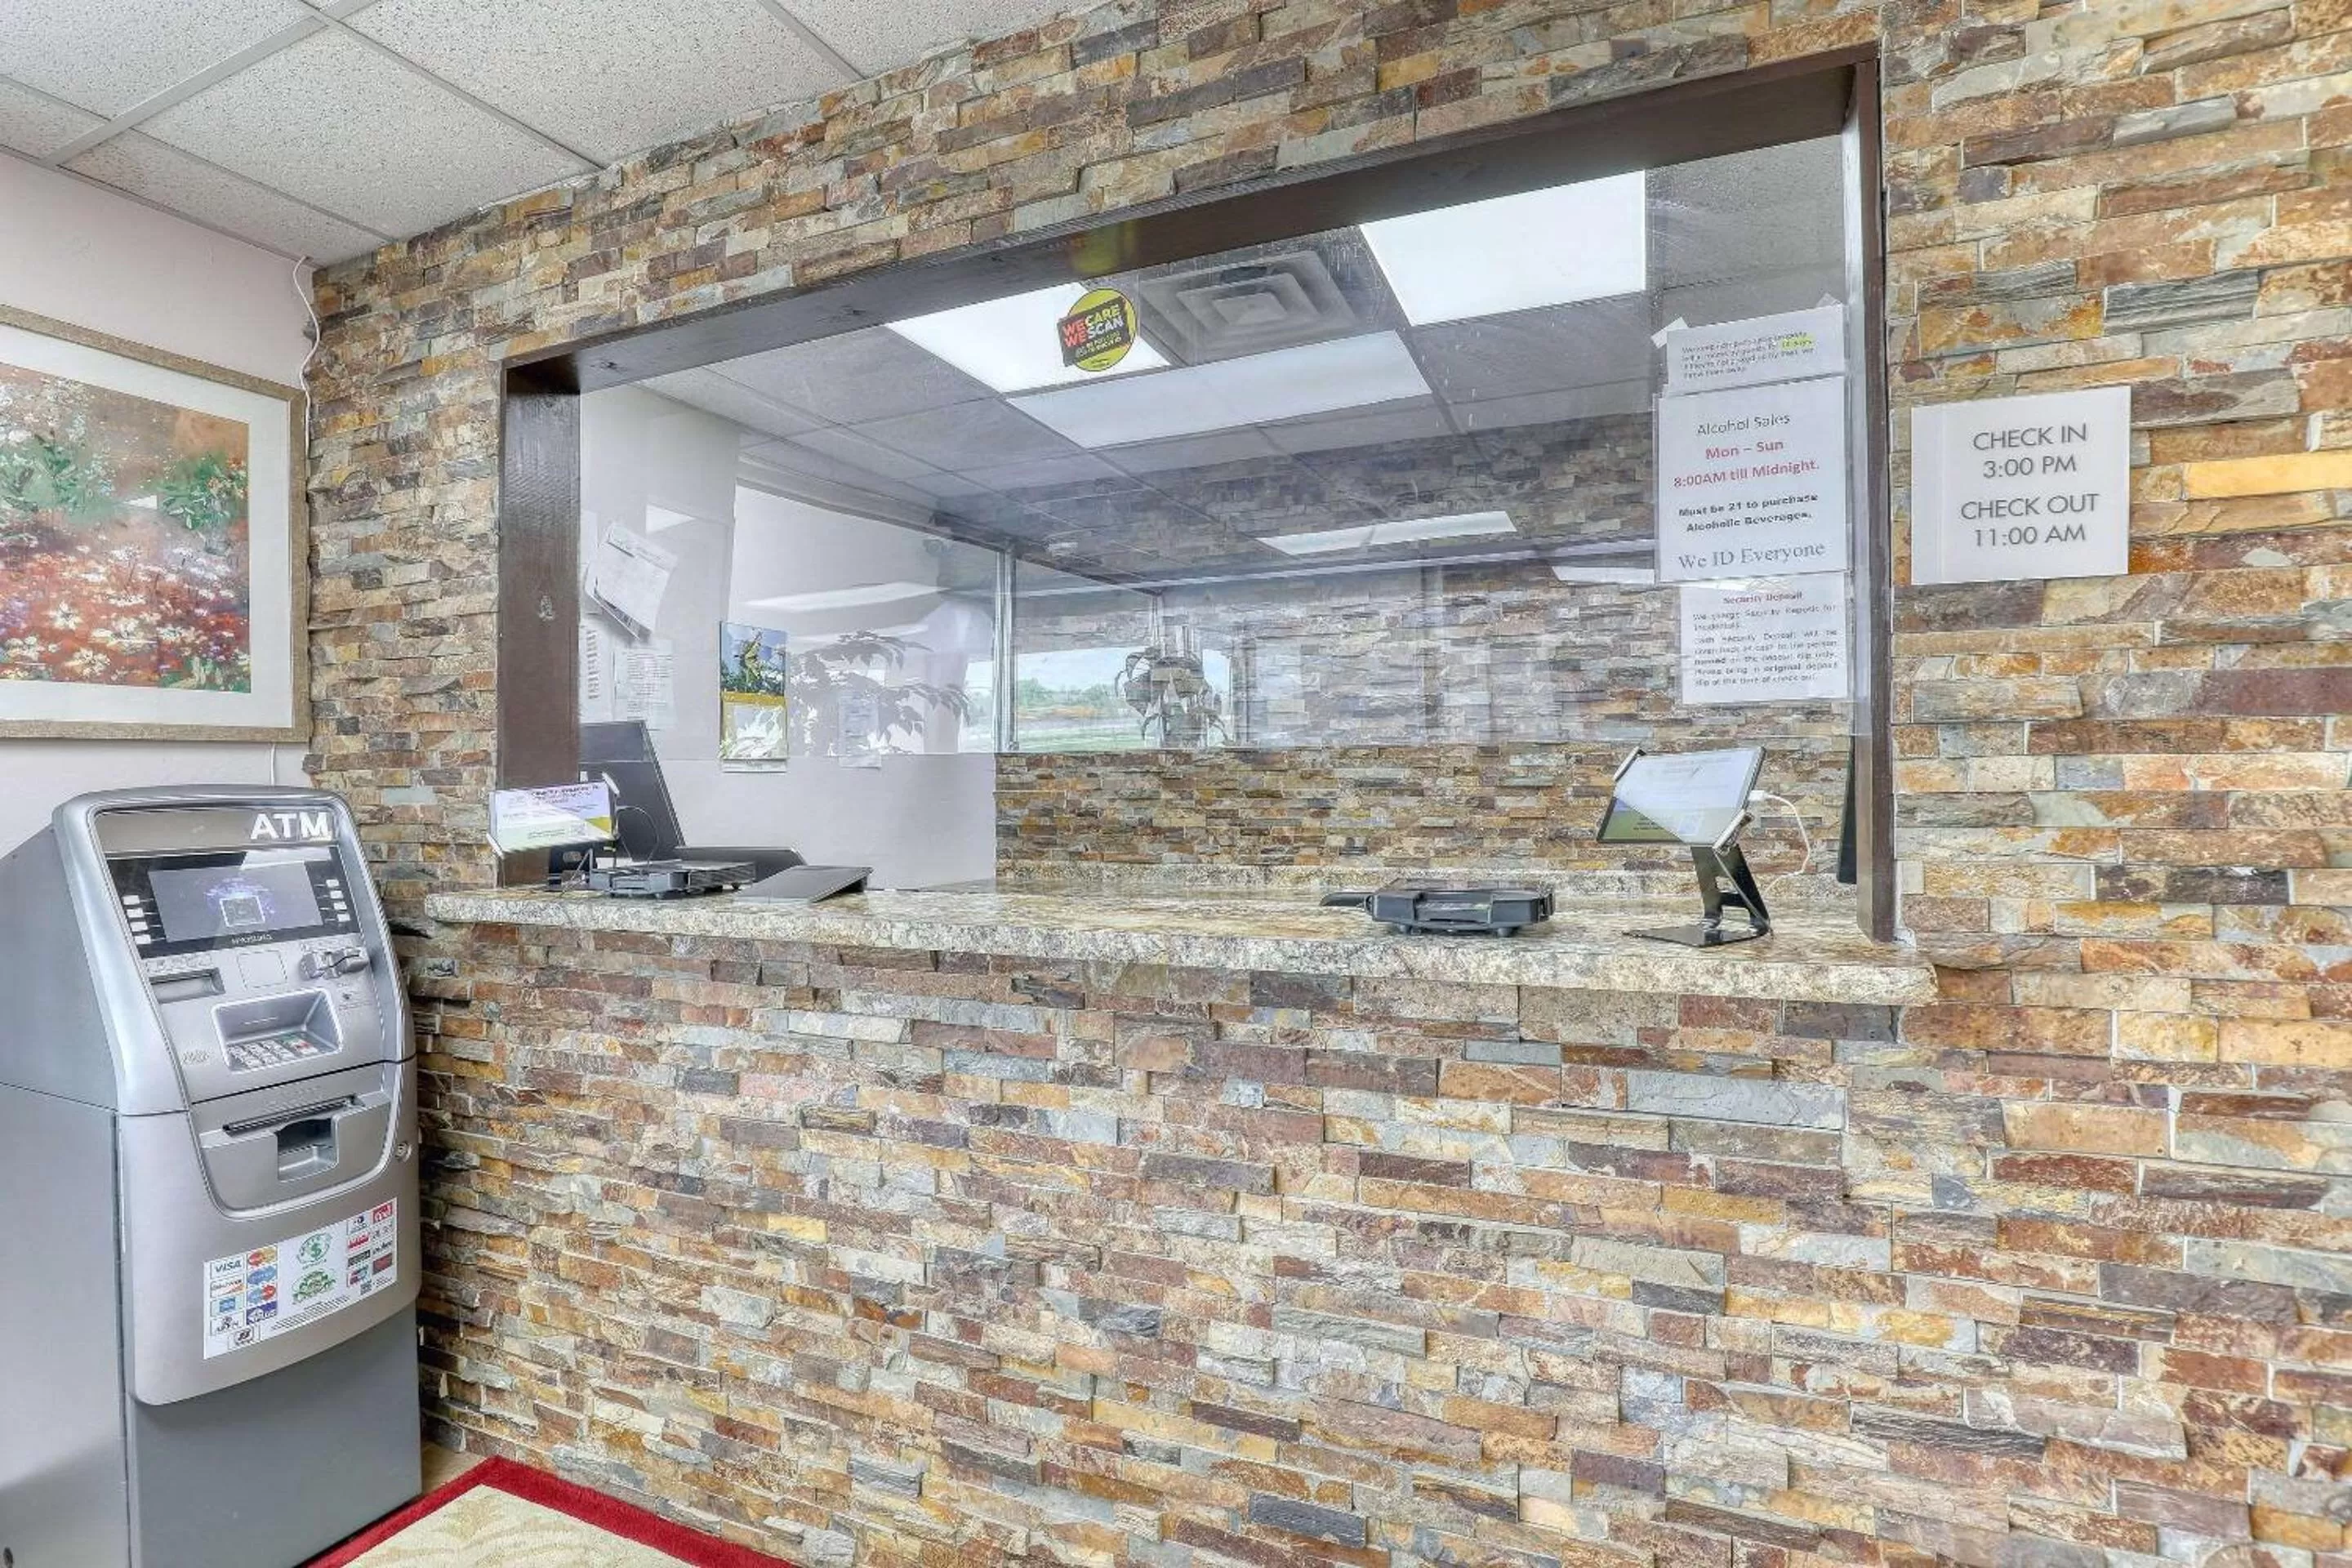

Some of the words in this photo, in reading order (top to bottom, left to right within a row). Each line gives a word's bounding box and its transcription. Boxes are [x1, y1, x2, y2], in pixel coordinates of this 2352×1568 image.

[1063, 319, 1086, 336] WE
[1085, 304, 1121, 327] CARE
[1064, 331, 1087, 347] WE
[1087, 315, 1124, 340] SCAN
[1697, 419, 1749, 435] Alcohol
[1753, 413, 1790, 425] Sales
[1973, 425, 2053, 451] CHECK
[2060, 423, 2087, 443] IN
[1705, 447, 1740, 460] Mon
[1756, 440, 1784, 452] Sun
[1674, 471, 1726, 488] 8:00AM
[1731, 468, 1748, 480] till
[1752, 460, 1820, 478] Midnight.
[1983, 457, 2034, 479] 3:00
[2042, 454, 2077, 474] PM
[1679, 507, 1707, 516] Must
[1710, 505, 1725, 514] be
[1729, 502, 1742, 510] 21
[1746, 501, 1758, 509] to
[1762, 493, 1818, 508] purchase
[1961, 497, 2040, 519] CHECK
[2047, 493, 2100, 514] OUT
[1686, 519, 1740, 532] Alcoholic
[1974, 525, 2038, 546] 11:00
[2044, 523, 2086, 543] AM
[1678, 555, 1707, 569] We
[1713, 550, 1735, 566] ID
[1740, 542, 1826, 564] Everyone
[250, 813, 332, 840] ATM
[216, 1260, 242, 1273] VISA
